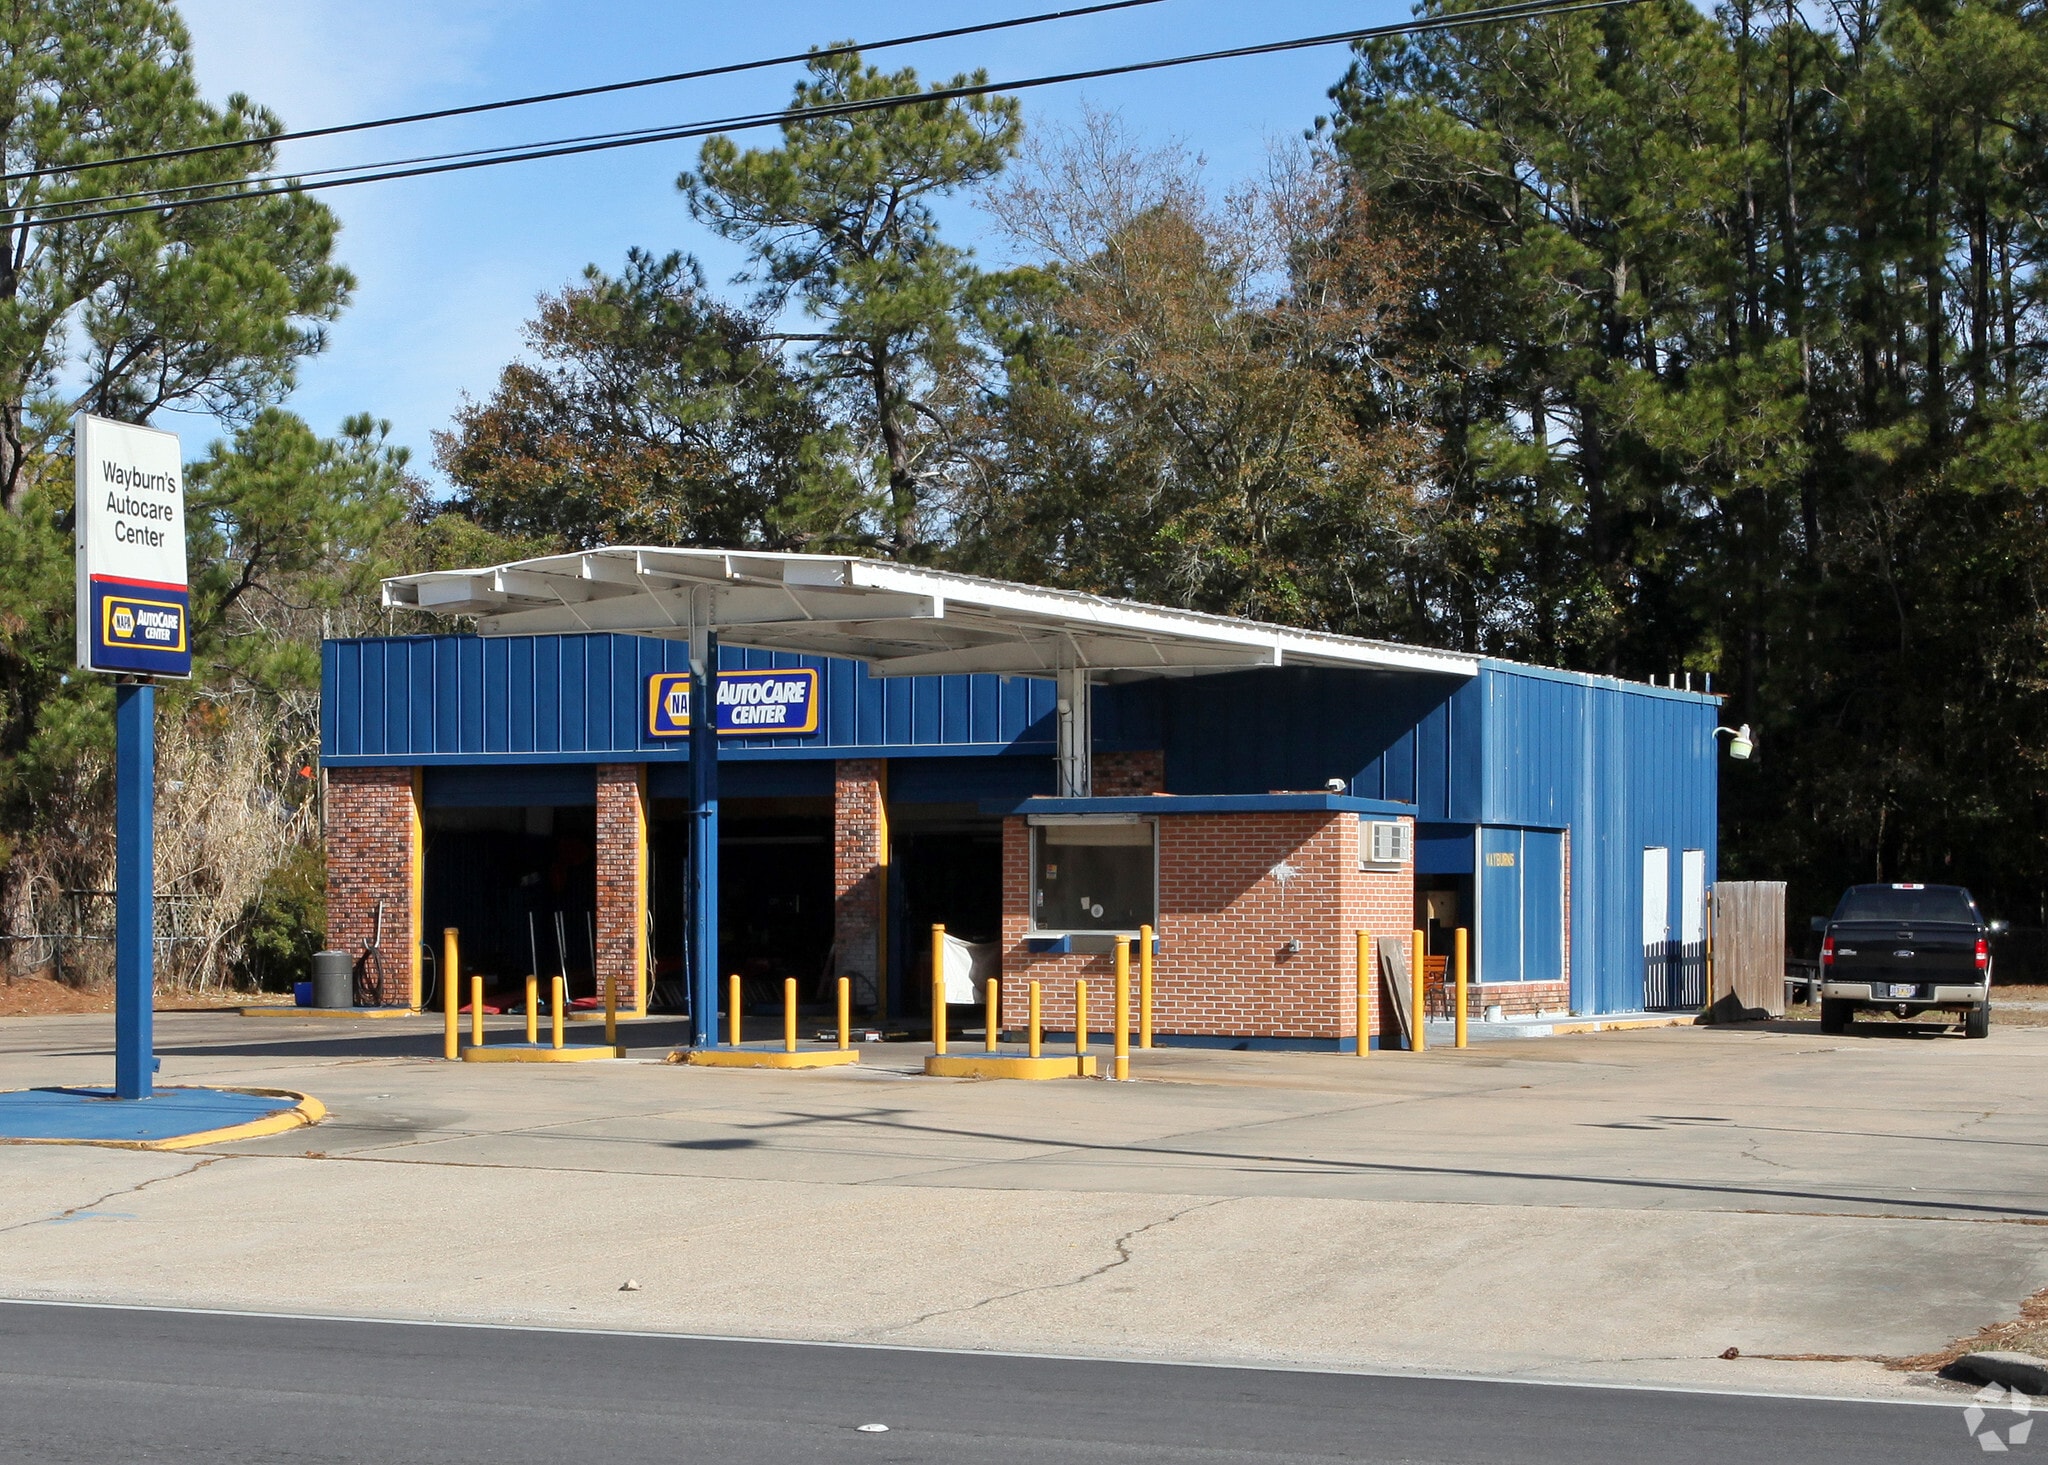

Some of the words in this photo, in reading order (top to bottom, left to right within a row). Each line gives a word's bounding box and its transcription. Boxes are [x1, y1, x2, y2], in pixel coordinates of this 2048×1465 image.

[102, 459, 176, 493] Wayburn's
[106, 490, 173, 522] Autocare
[114, 520, 165, 548] Center
[116, 614, 132, 630] NAPA
[144, 627, 171, 641] CENTER
[731, 705, 787, 724] CENTER
